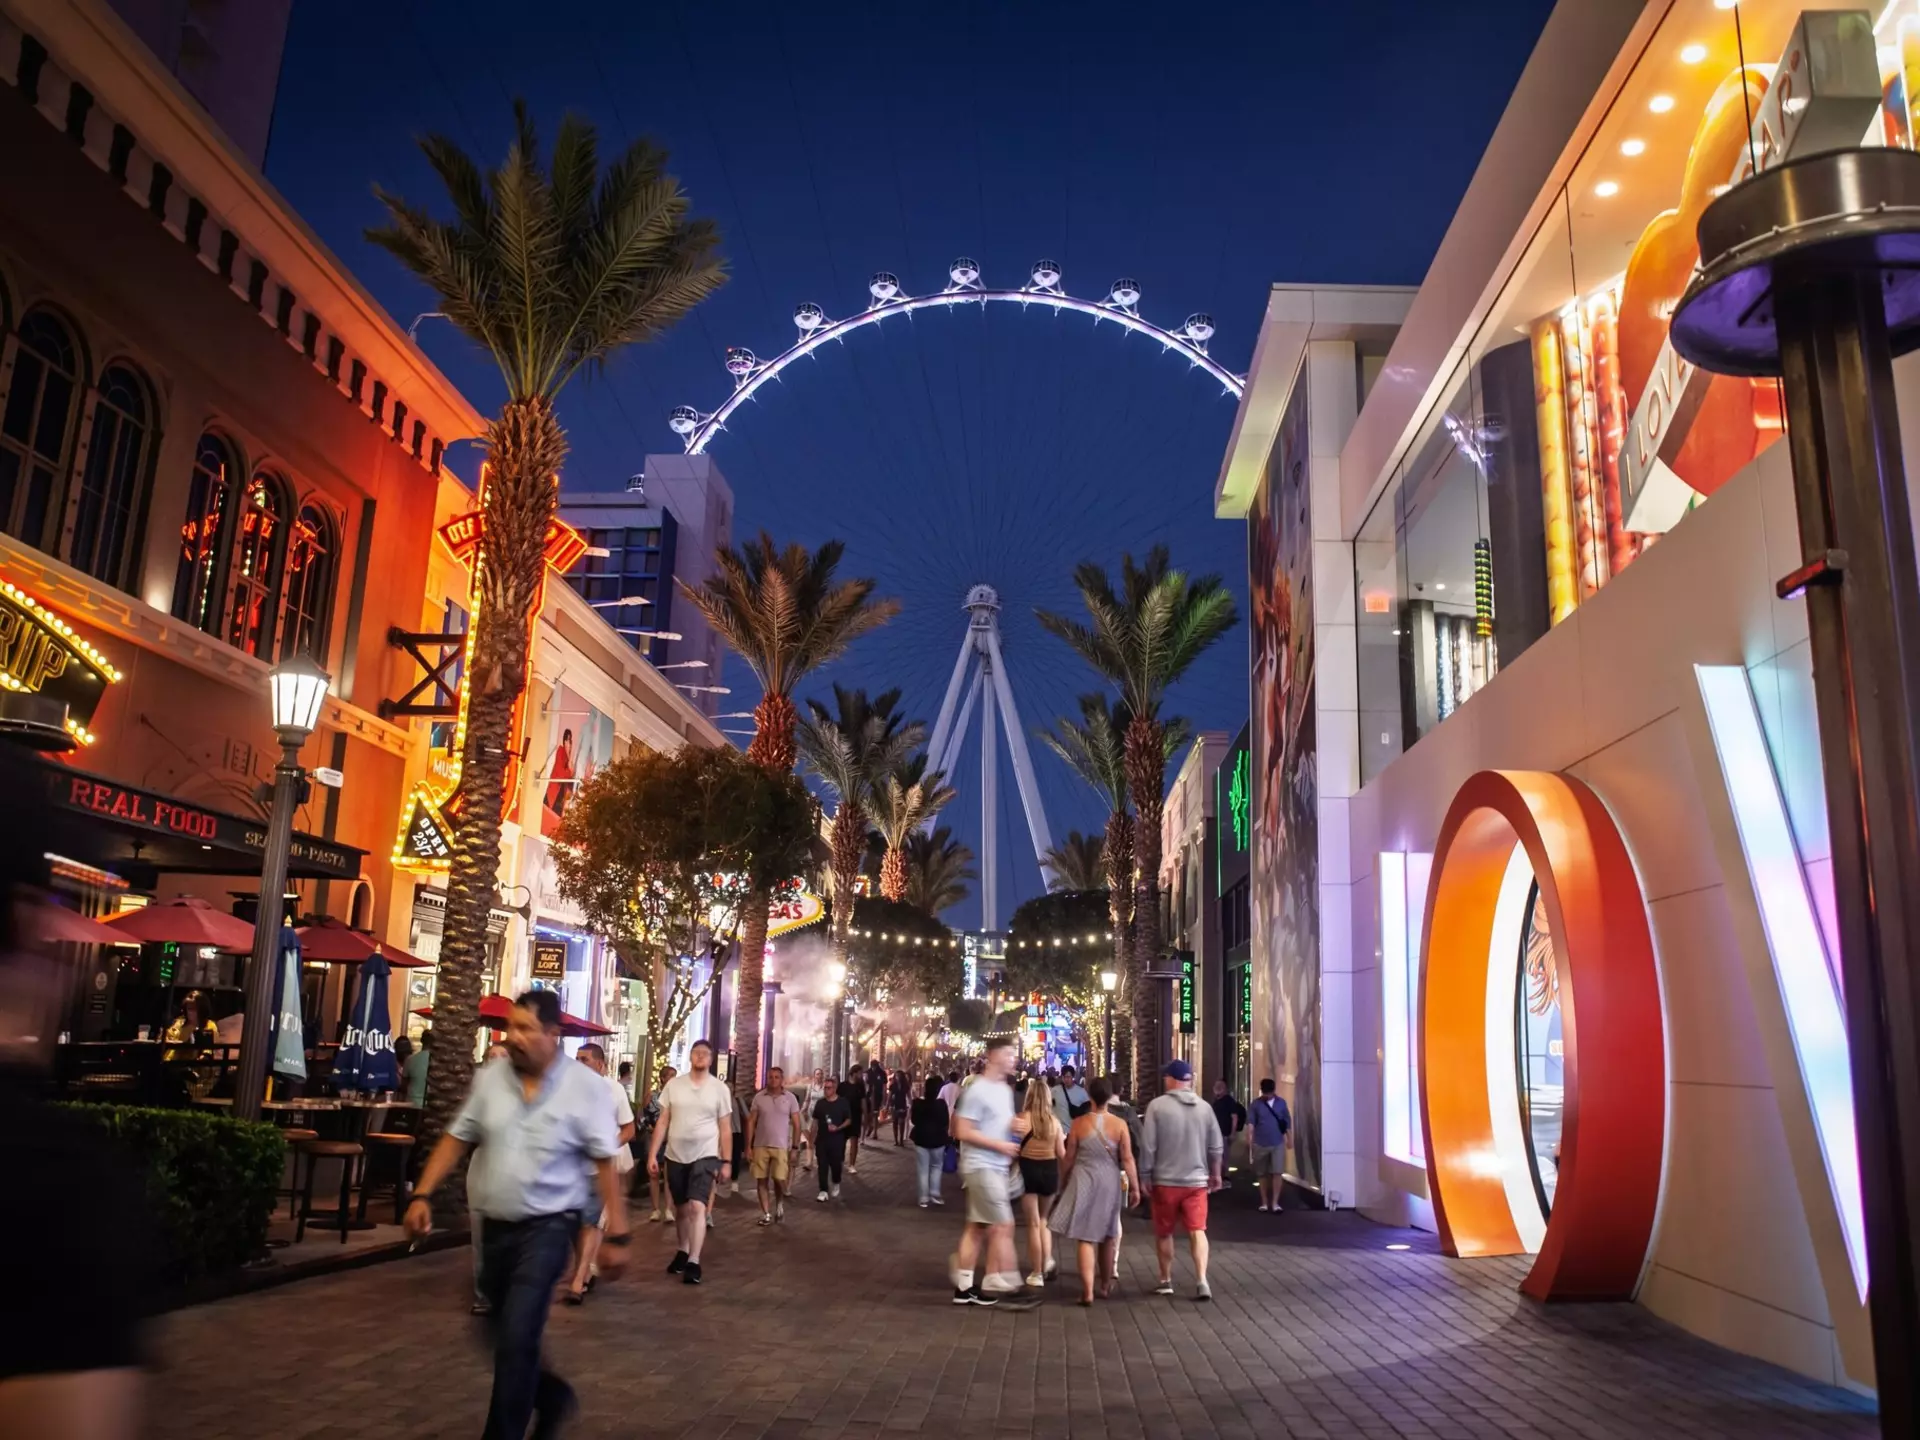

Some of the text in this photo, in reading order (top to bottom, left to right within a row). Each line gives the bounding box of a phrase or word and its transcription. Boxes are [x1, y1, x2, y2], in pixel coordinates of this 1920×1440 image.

[68, 777, 147, 823] REAL
[153, 800, 218, 840] FOOD
[412, 831, 434, 857] 23/7
[419, 817, 448, 856] OPEN
[308, 845, 346, 869] PASTA
[768, 903, 803, 919] GAS
[538, 961, 560, 970] LOFT
[540, 953, 558, 961] HAT
[1182, 962, 1191, 1023] RAZER
